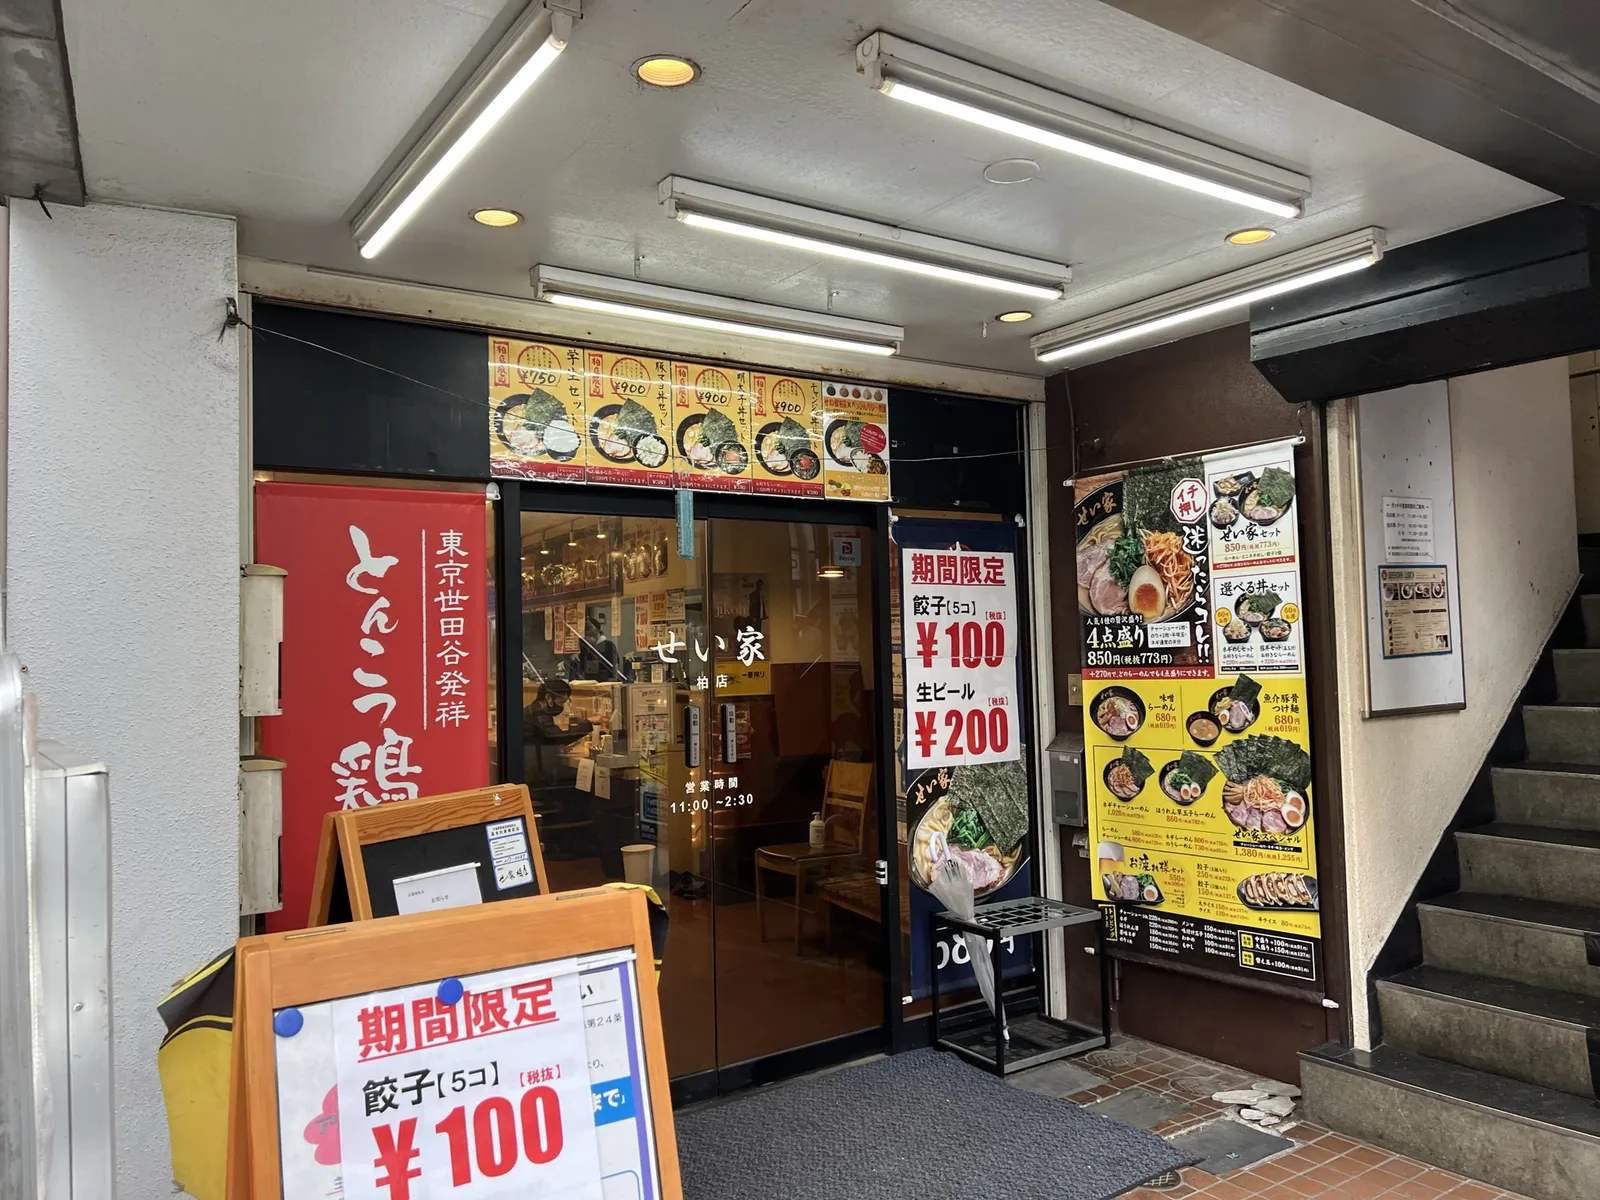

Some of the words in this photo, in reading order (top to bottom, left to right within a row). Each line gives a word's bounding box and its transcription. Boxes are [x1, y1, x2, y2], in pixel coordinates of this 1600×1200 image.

[522, 369, 556, 385] ¥750
[566, 349, 582, 430] 学生セット
[614, 381, 646, 394] ¥900
[699, 391, 727, 404] ¥900
[774, 401, 802, 413] ¥900
[1177, 484, 1199, 501] イチ
[1076, 491, 1117, 526] せい家
[1179, 502, 1203, 518] 押し
[1219, 522, 1281, 542] せい家セット
[911, 553, 1006, 585] 期間限定
[1220, 579, 1290, 597] 選べる丼セット
[912, 594, 977, 616] 餃子【5コ】
[984, 610, 1007, 621] 【税抜】
[434, 528, 470, 728] 東京世田谷発祥
[916, 621, 1005, 669] ¥100
[1086, 625, 1145, 649] 4点盛り
[649, 625, 765, 667] せい家
[696, 674, 728, 690] 柏店
[916, 682, 976, 703] 生ビール
[987, 696, 1009, 706] 【税抜】
[1159, 694, 1174, 703] 味噌
[1263, 693, 1299, 704] 魚介豚骨
[1148, 703, 1176, 711] らーめん
[1272, 704, 1300, 714] つけ麺
[1155, 712, 1177, 722] 680円
[1274, 714, 1301, 725] 680円
[915, 707, 1009, 758] ¥200
[685, 777, 739, 794] 営業時間
[914, 767, 951, 805] せい家
[670, 799, 709, 813] 11:00
[1232, 828, 1302, 843] せい家スペシャル
[1169, 873, 1185, 882] 550円
[357, 976, 557, 1060] 期間限定
[584, 1013, 622, 1029] 第24条
[517, 1063, 562, 1087] 【税抜】
[361, 1061, 499, 1117] 餃子【5コ】
[371, 1085, 565, 1200] ¥100
